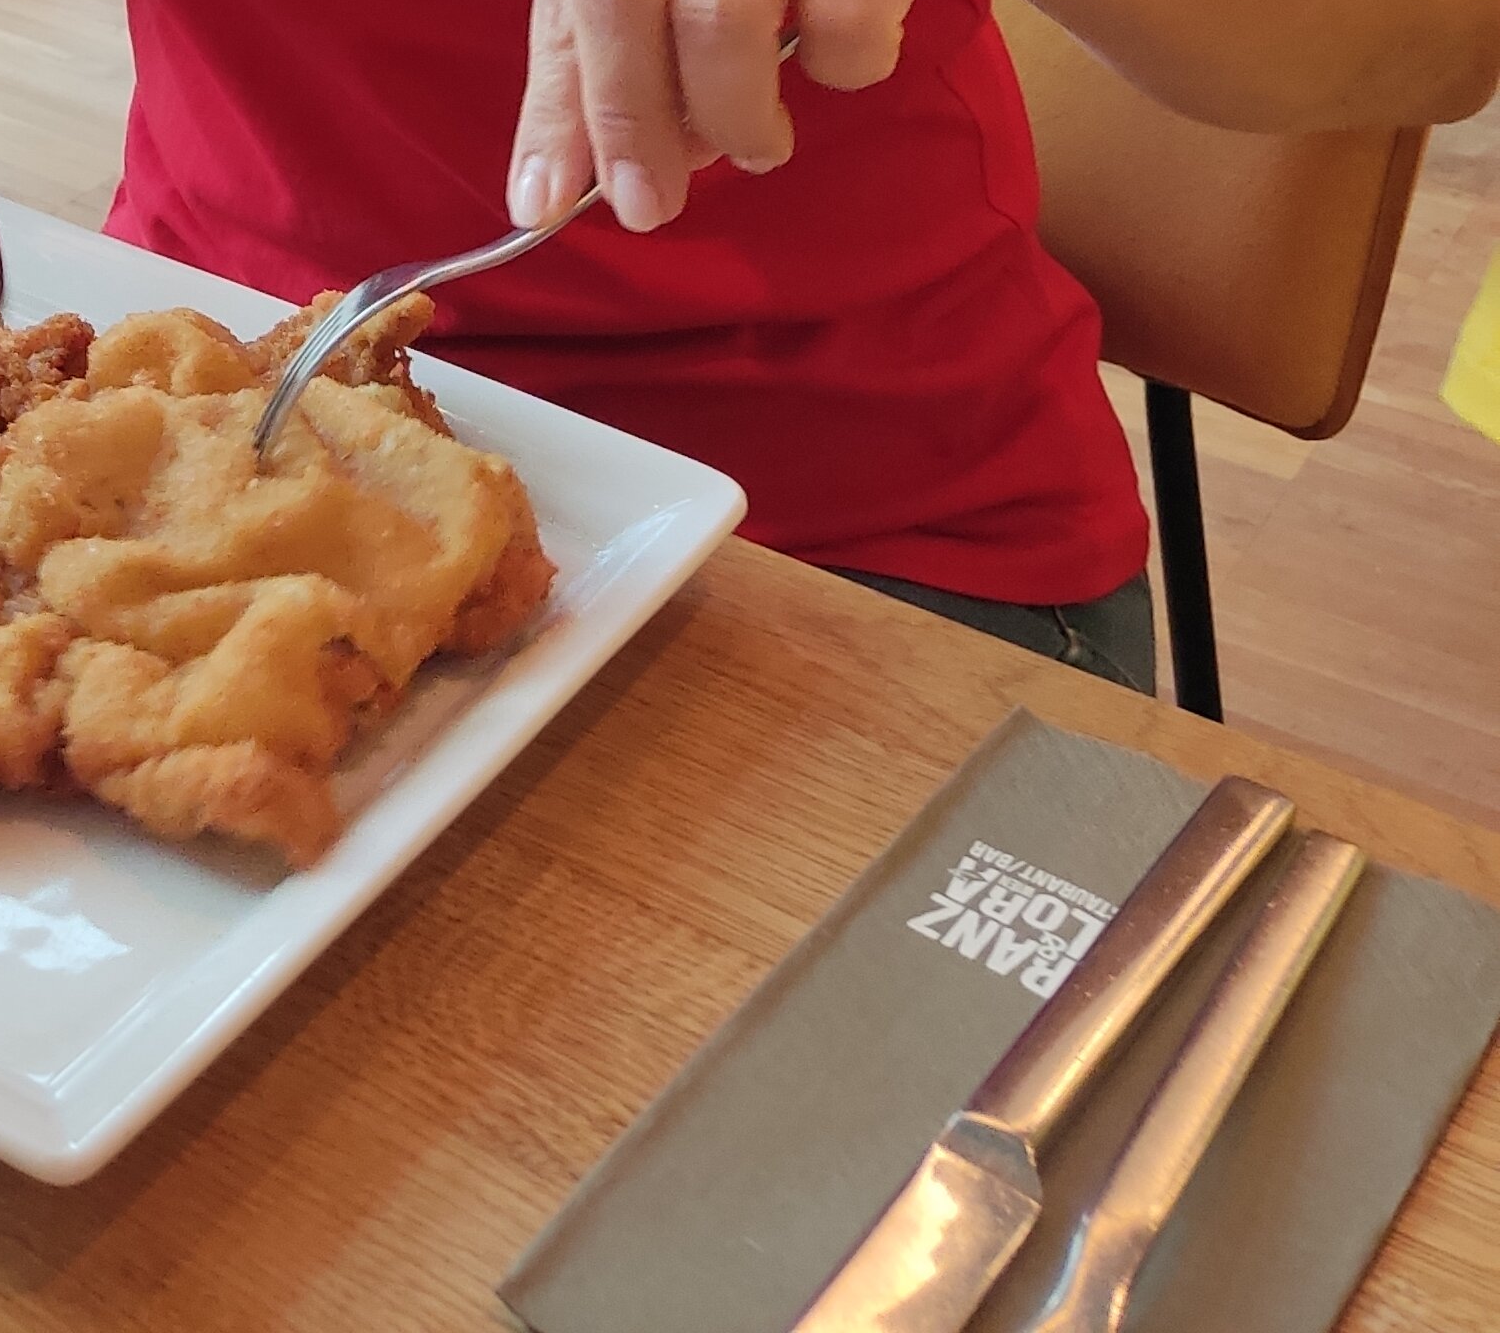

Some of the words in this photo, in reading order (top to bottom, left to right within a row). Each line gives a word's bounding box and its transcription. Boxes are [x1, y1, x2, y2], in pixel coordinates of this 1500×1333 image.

[947, 855, 1112, 963] LORA
[969, 839, 1119, 921] TAURANT/BAR
[906, 891, 1079, 1000] RANZ
